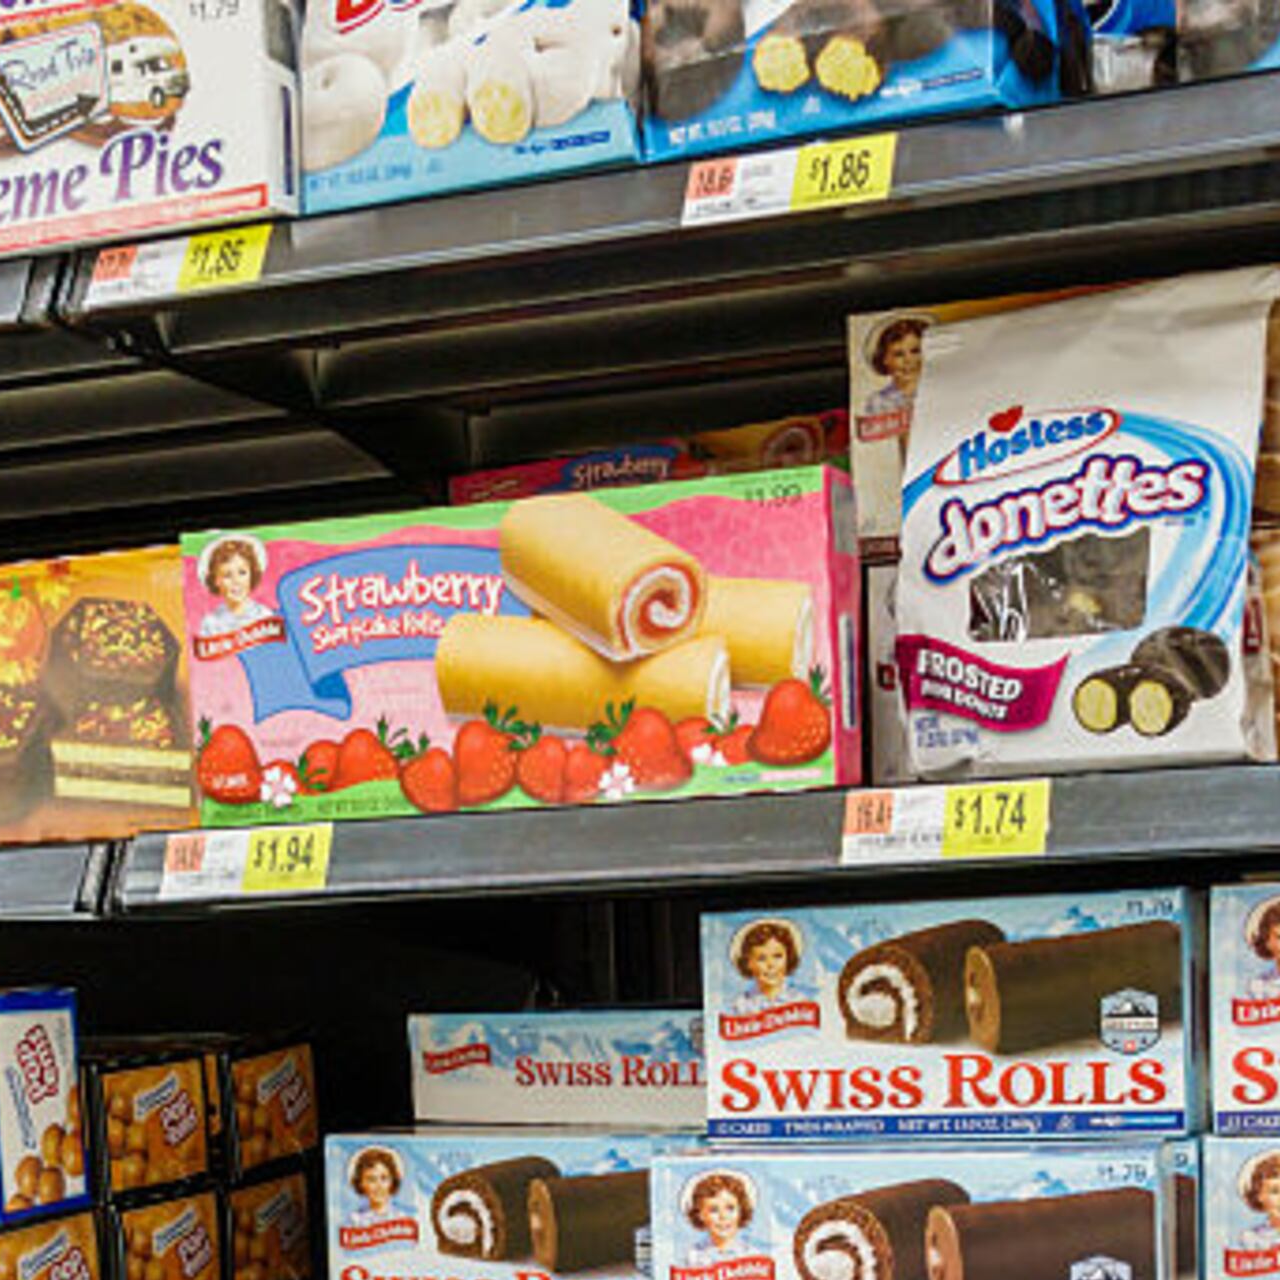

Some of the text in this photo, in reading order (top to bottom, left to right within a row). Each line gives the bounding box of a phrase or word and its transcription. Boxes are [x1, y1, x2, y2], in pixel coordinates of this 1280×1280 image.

[98, 131, 225, 193] Pies
[810, 149, 872, 194] $1.86
[956, 408, 1107, 479] Hostess
[571, 453, 671, 488] Strawberry
[926, 456, 1210, 582] donettes
[298, 562, 504, 623] Strawberry
[917, 649, 1023, 701] FROSTED
[955, 793, 1027, 835] $1.74
[253, 833, 317, 872] $1.94
[723, 1013, 769, 1039] Little
[515, 1054, 612, 1089] SWISS
[721, 1054, 1167, 1114] SWISS ROLLS
[1227, 1248, 1274, 1275] Little
